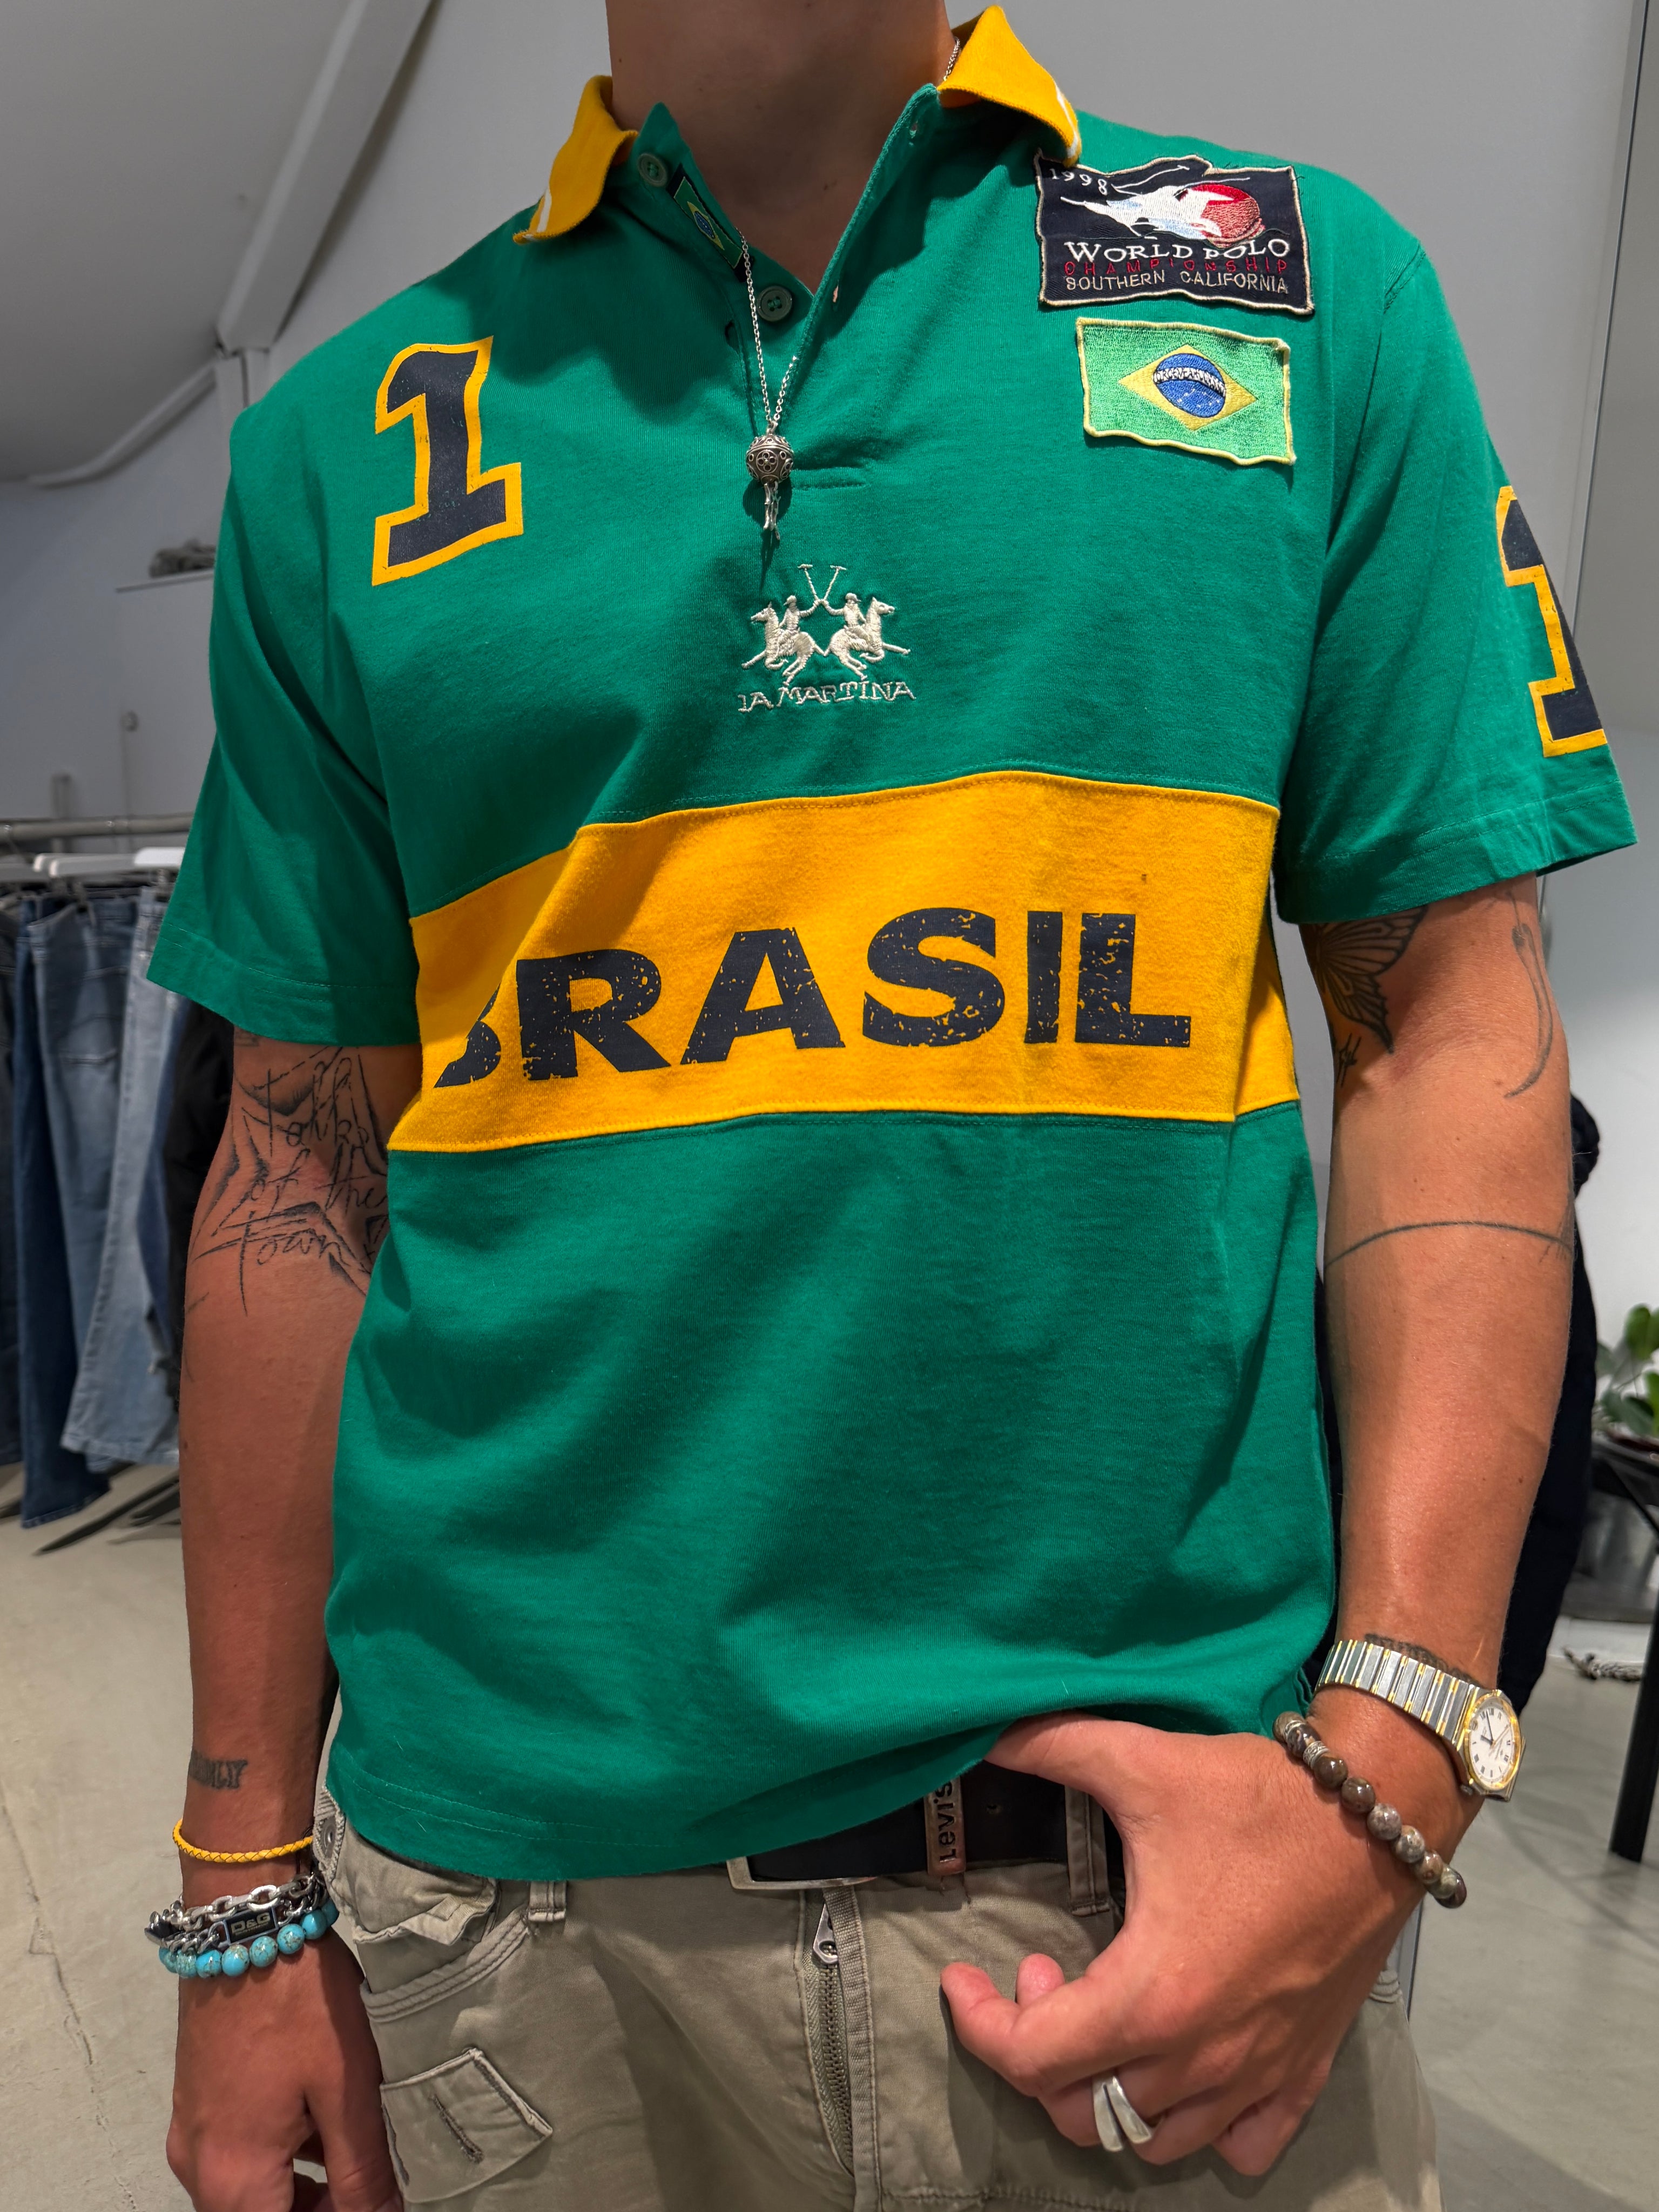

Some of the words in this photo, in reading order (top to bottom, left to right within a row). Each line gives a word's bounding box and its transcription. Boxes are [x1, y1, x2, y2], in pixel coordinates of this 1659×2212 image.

[1049, 168, 1108, 195] 1998
[1063, 241, 1193, 262] WORLD
[1203, 239, 1290, 260] POLO
[1065, 269, 1165, 291] SOUTHERN
[1179, 271, 1289, 294] CALIFORNIA
[372, 335, 524, 586] 1
[776, 681, 916, 707] MARTINA
[231, 1912, 271, 1933] D&G
